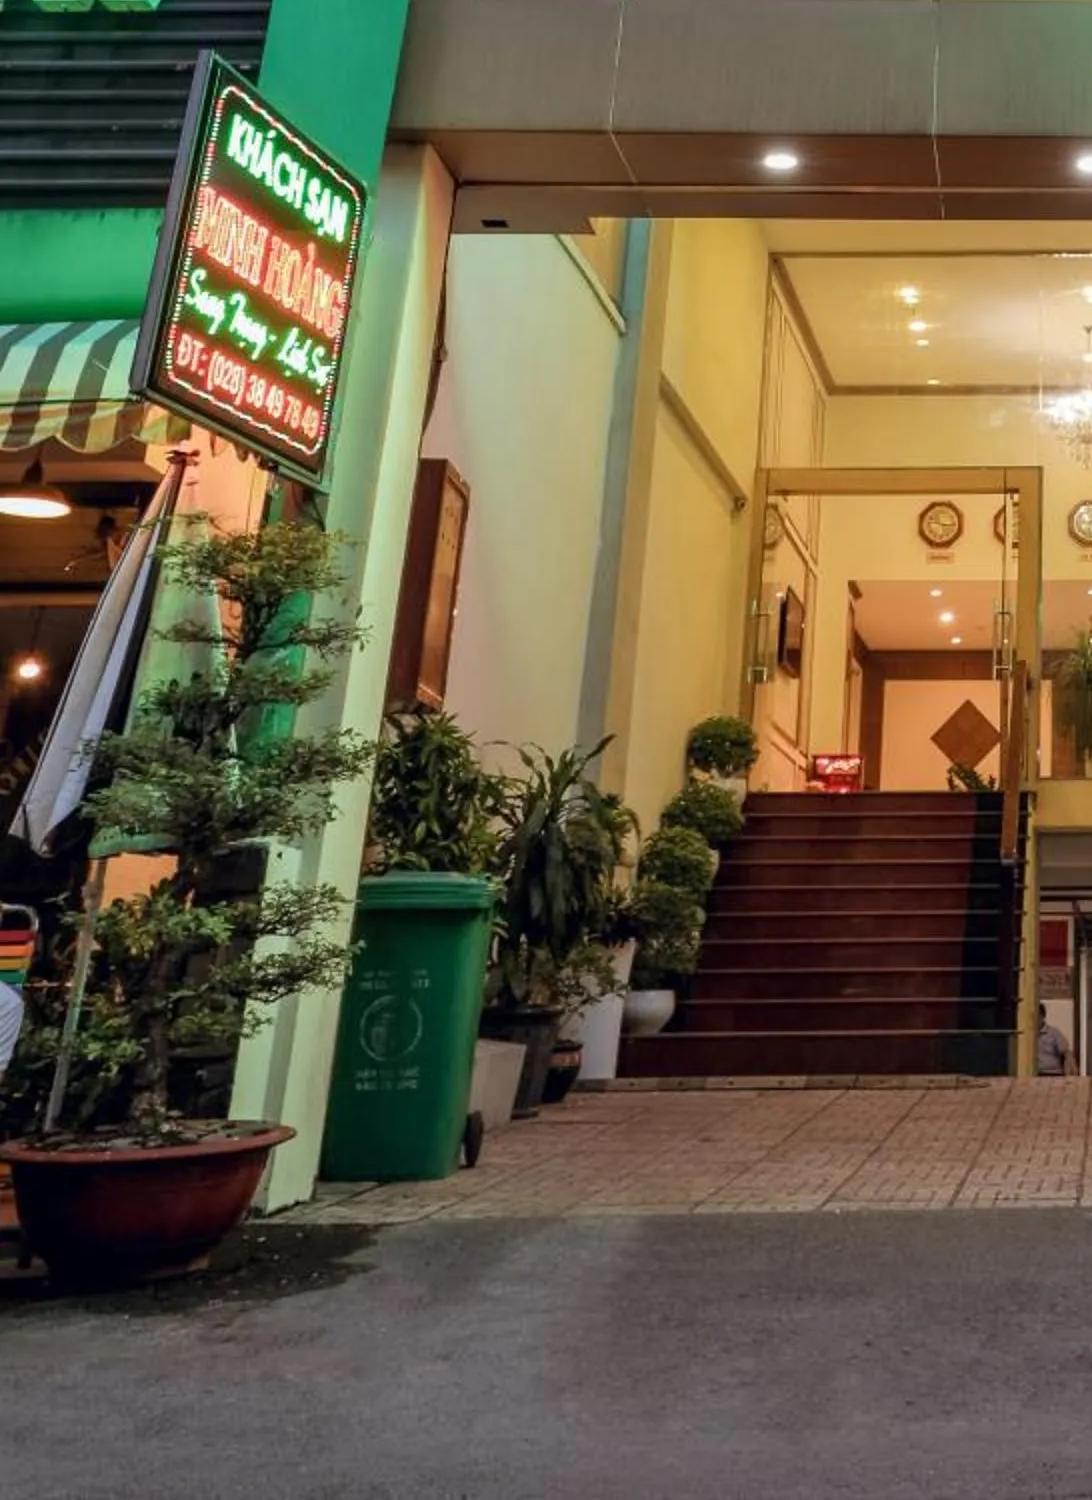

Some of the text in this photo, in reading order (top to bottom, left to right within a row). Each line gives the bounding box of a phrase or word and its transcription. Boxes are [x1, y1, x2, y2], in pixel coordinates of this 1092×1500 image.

[227, 113, 348, 241] KHÁCH SẠN
[194, 188, 268, 286] MINH
[176, 333, 208, 376] ĐT:
[208, 351, 246, 405] (028)
[246, 375, 266, 408] 38
[265, 385, 285, 418] 49
